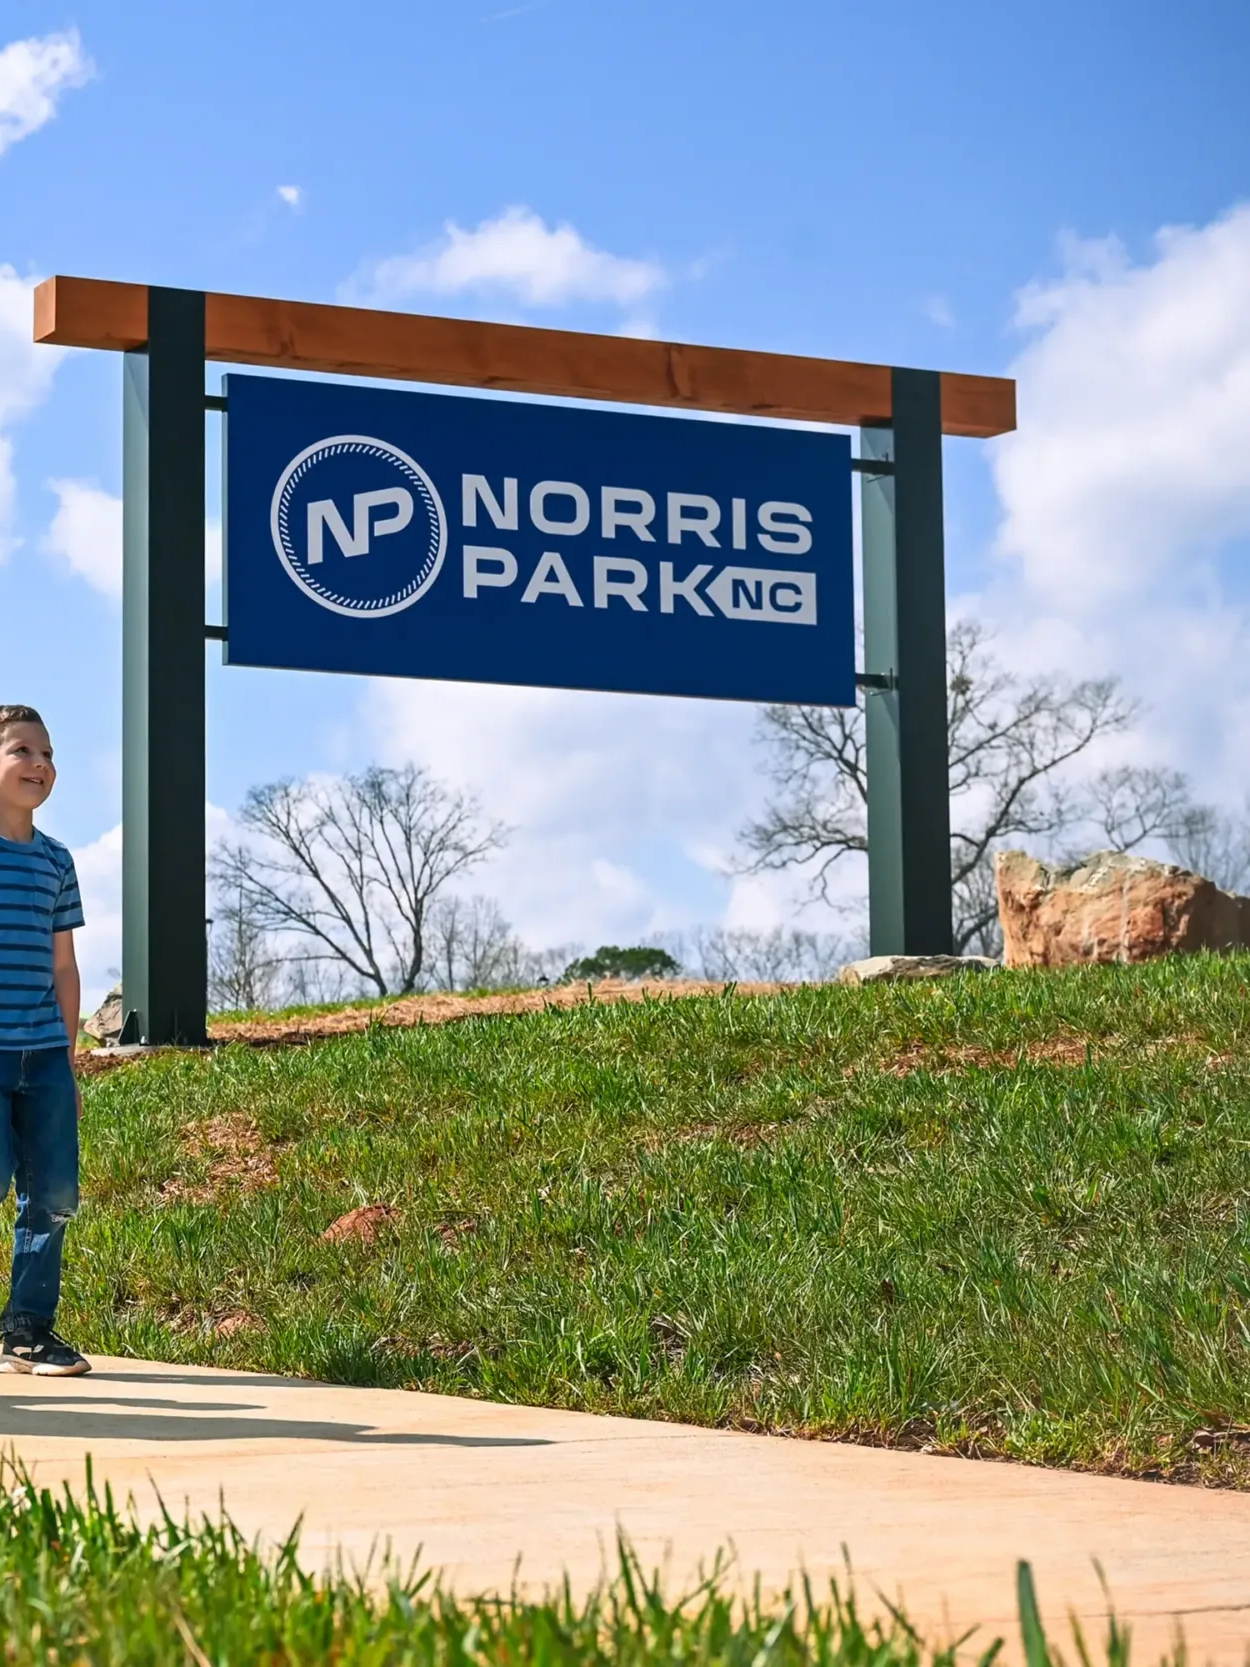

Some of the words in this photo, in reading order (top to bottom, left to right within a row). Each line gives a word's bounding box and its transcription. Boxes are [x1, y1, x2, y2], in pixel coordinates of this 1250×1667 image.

[307, 486, 414, 565] NP
[461, 473, 813, 555] NORRIS
[462, 544, 715, 617] PARK
[732, 578, 803, 614] NC
